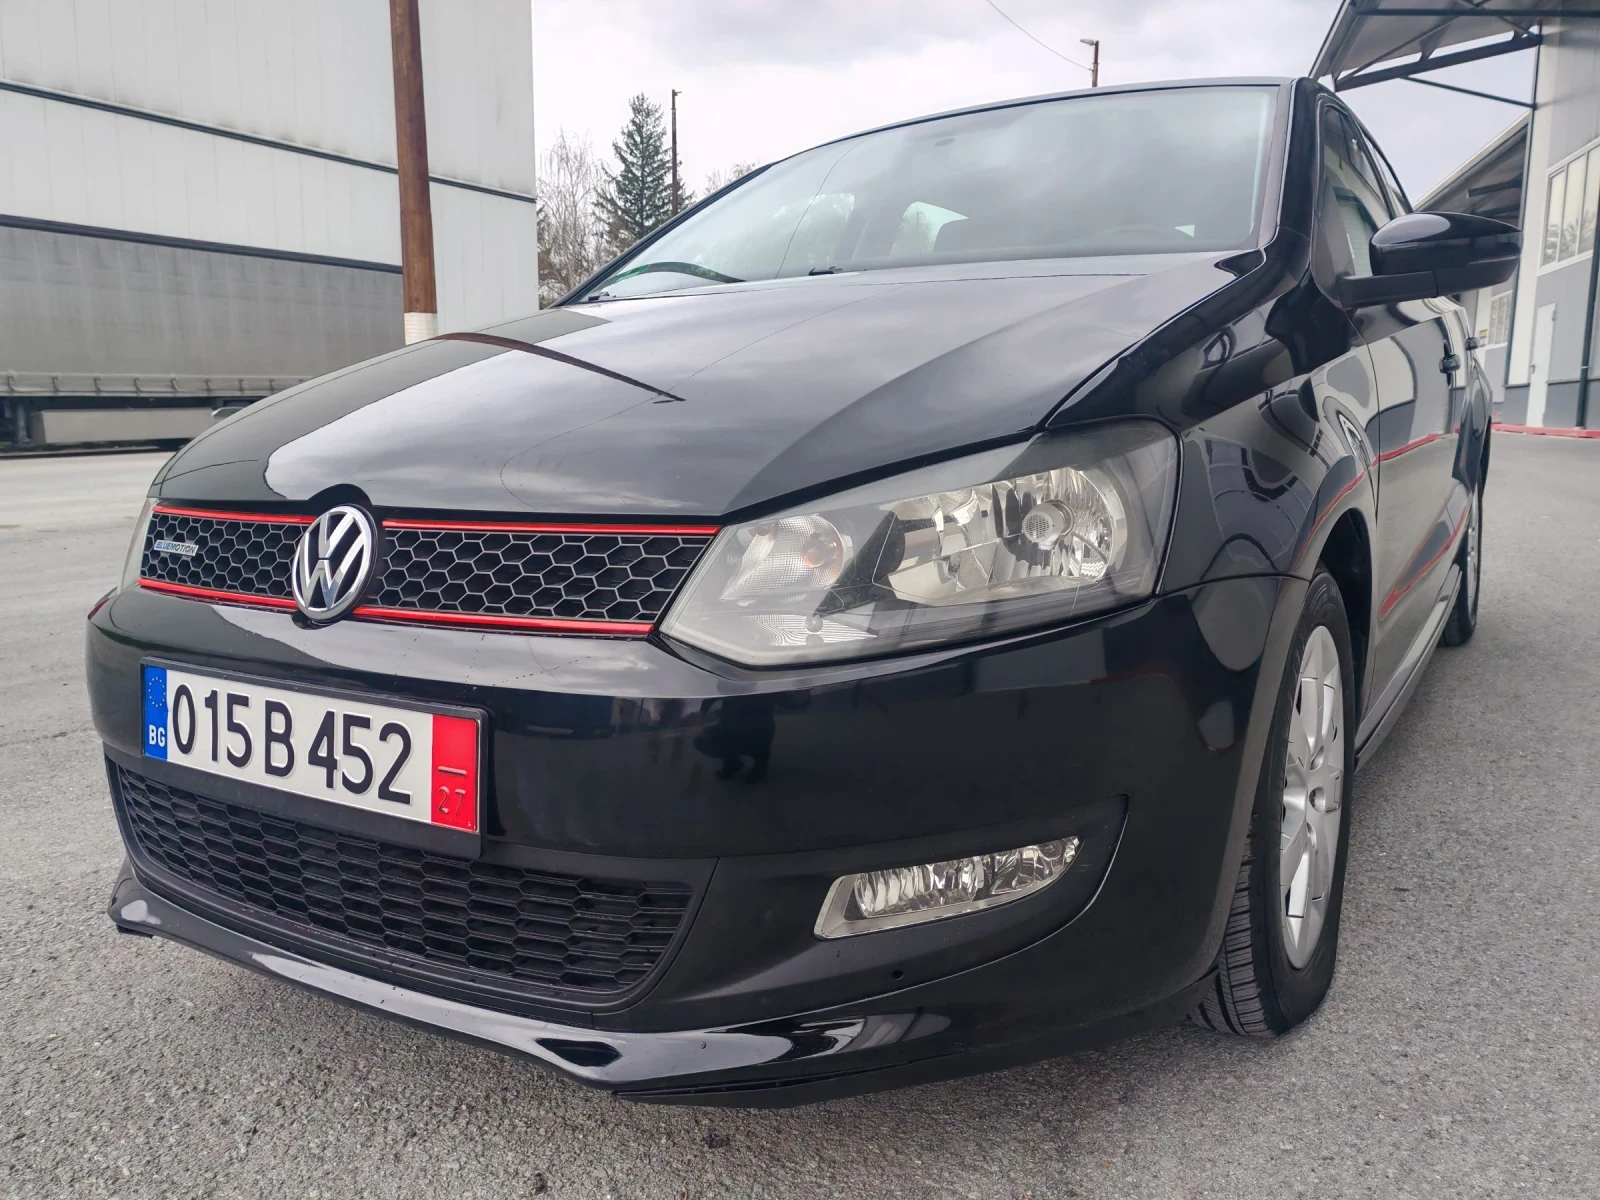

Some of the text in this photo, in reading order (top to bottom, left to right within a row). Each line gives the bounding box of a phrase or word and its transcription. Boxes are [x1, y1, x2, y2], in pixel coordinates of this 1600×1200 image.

[155, 541, 197, 554] BLUEMOTION
[295, 508, 370, 617] VW
[149, 724, 166, 747] BG
[438, 786, 467, 816] 27
